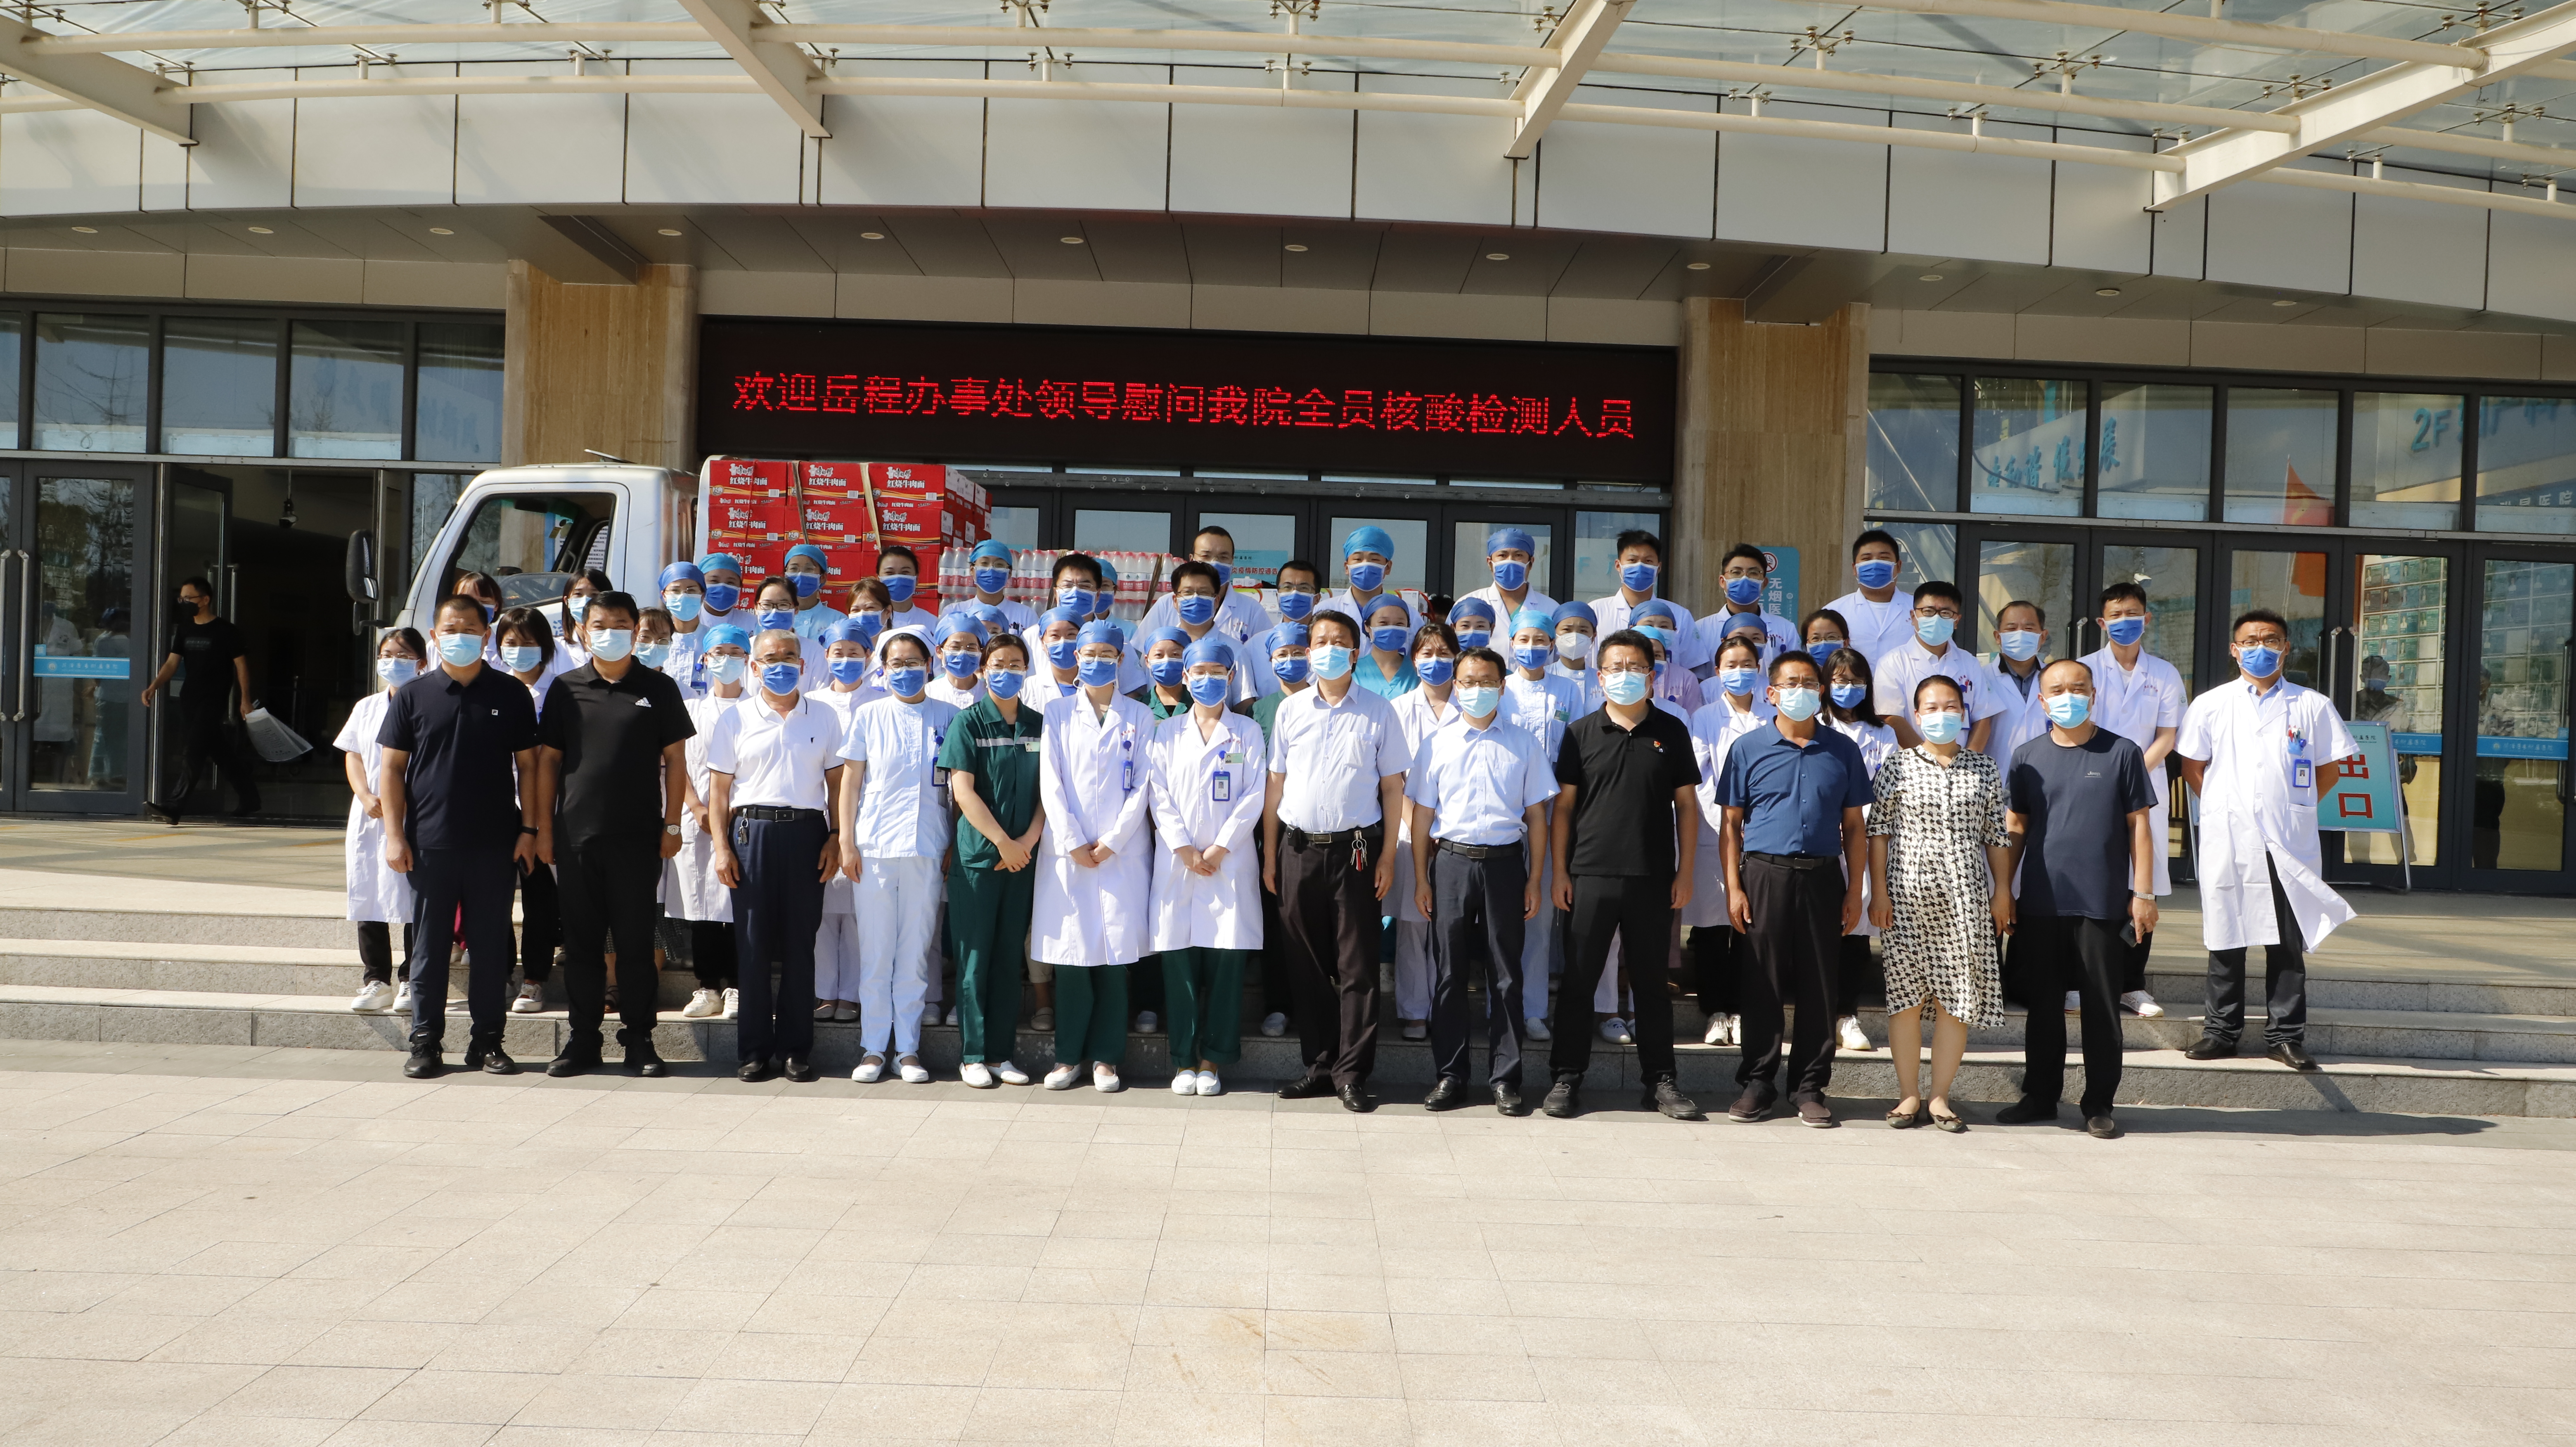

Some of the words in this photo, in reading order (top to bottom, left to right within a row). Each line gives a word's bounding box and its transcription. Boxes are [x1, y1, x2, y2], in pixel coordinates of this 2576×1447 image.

[732, 371, 1634, 439] 欢迎岳程办事处领导慰问我院全员核酸检测人员
[729, 476, 767, 486] 红烧牛肉面
[808, 477, 847, 486] 红烧牛肉面
[887, 479, 926, 489] 红烧牛肉面
[729, 520, 767, 529] 红烧牛肉面
[806, 522, 844, 531] 红烧牛肉面
[883, 522, 921, 532] 红烧牛肉面
[1232, 567, 1278, 575] 炎疫情防控通告
[2338, 754, 2374, 819] 出口
